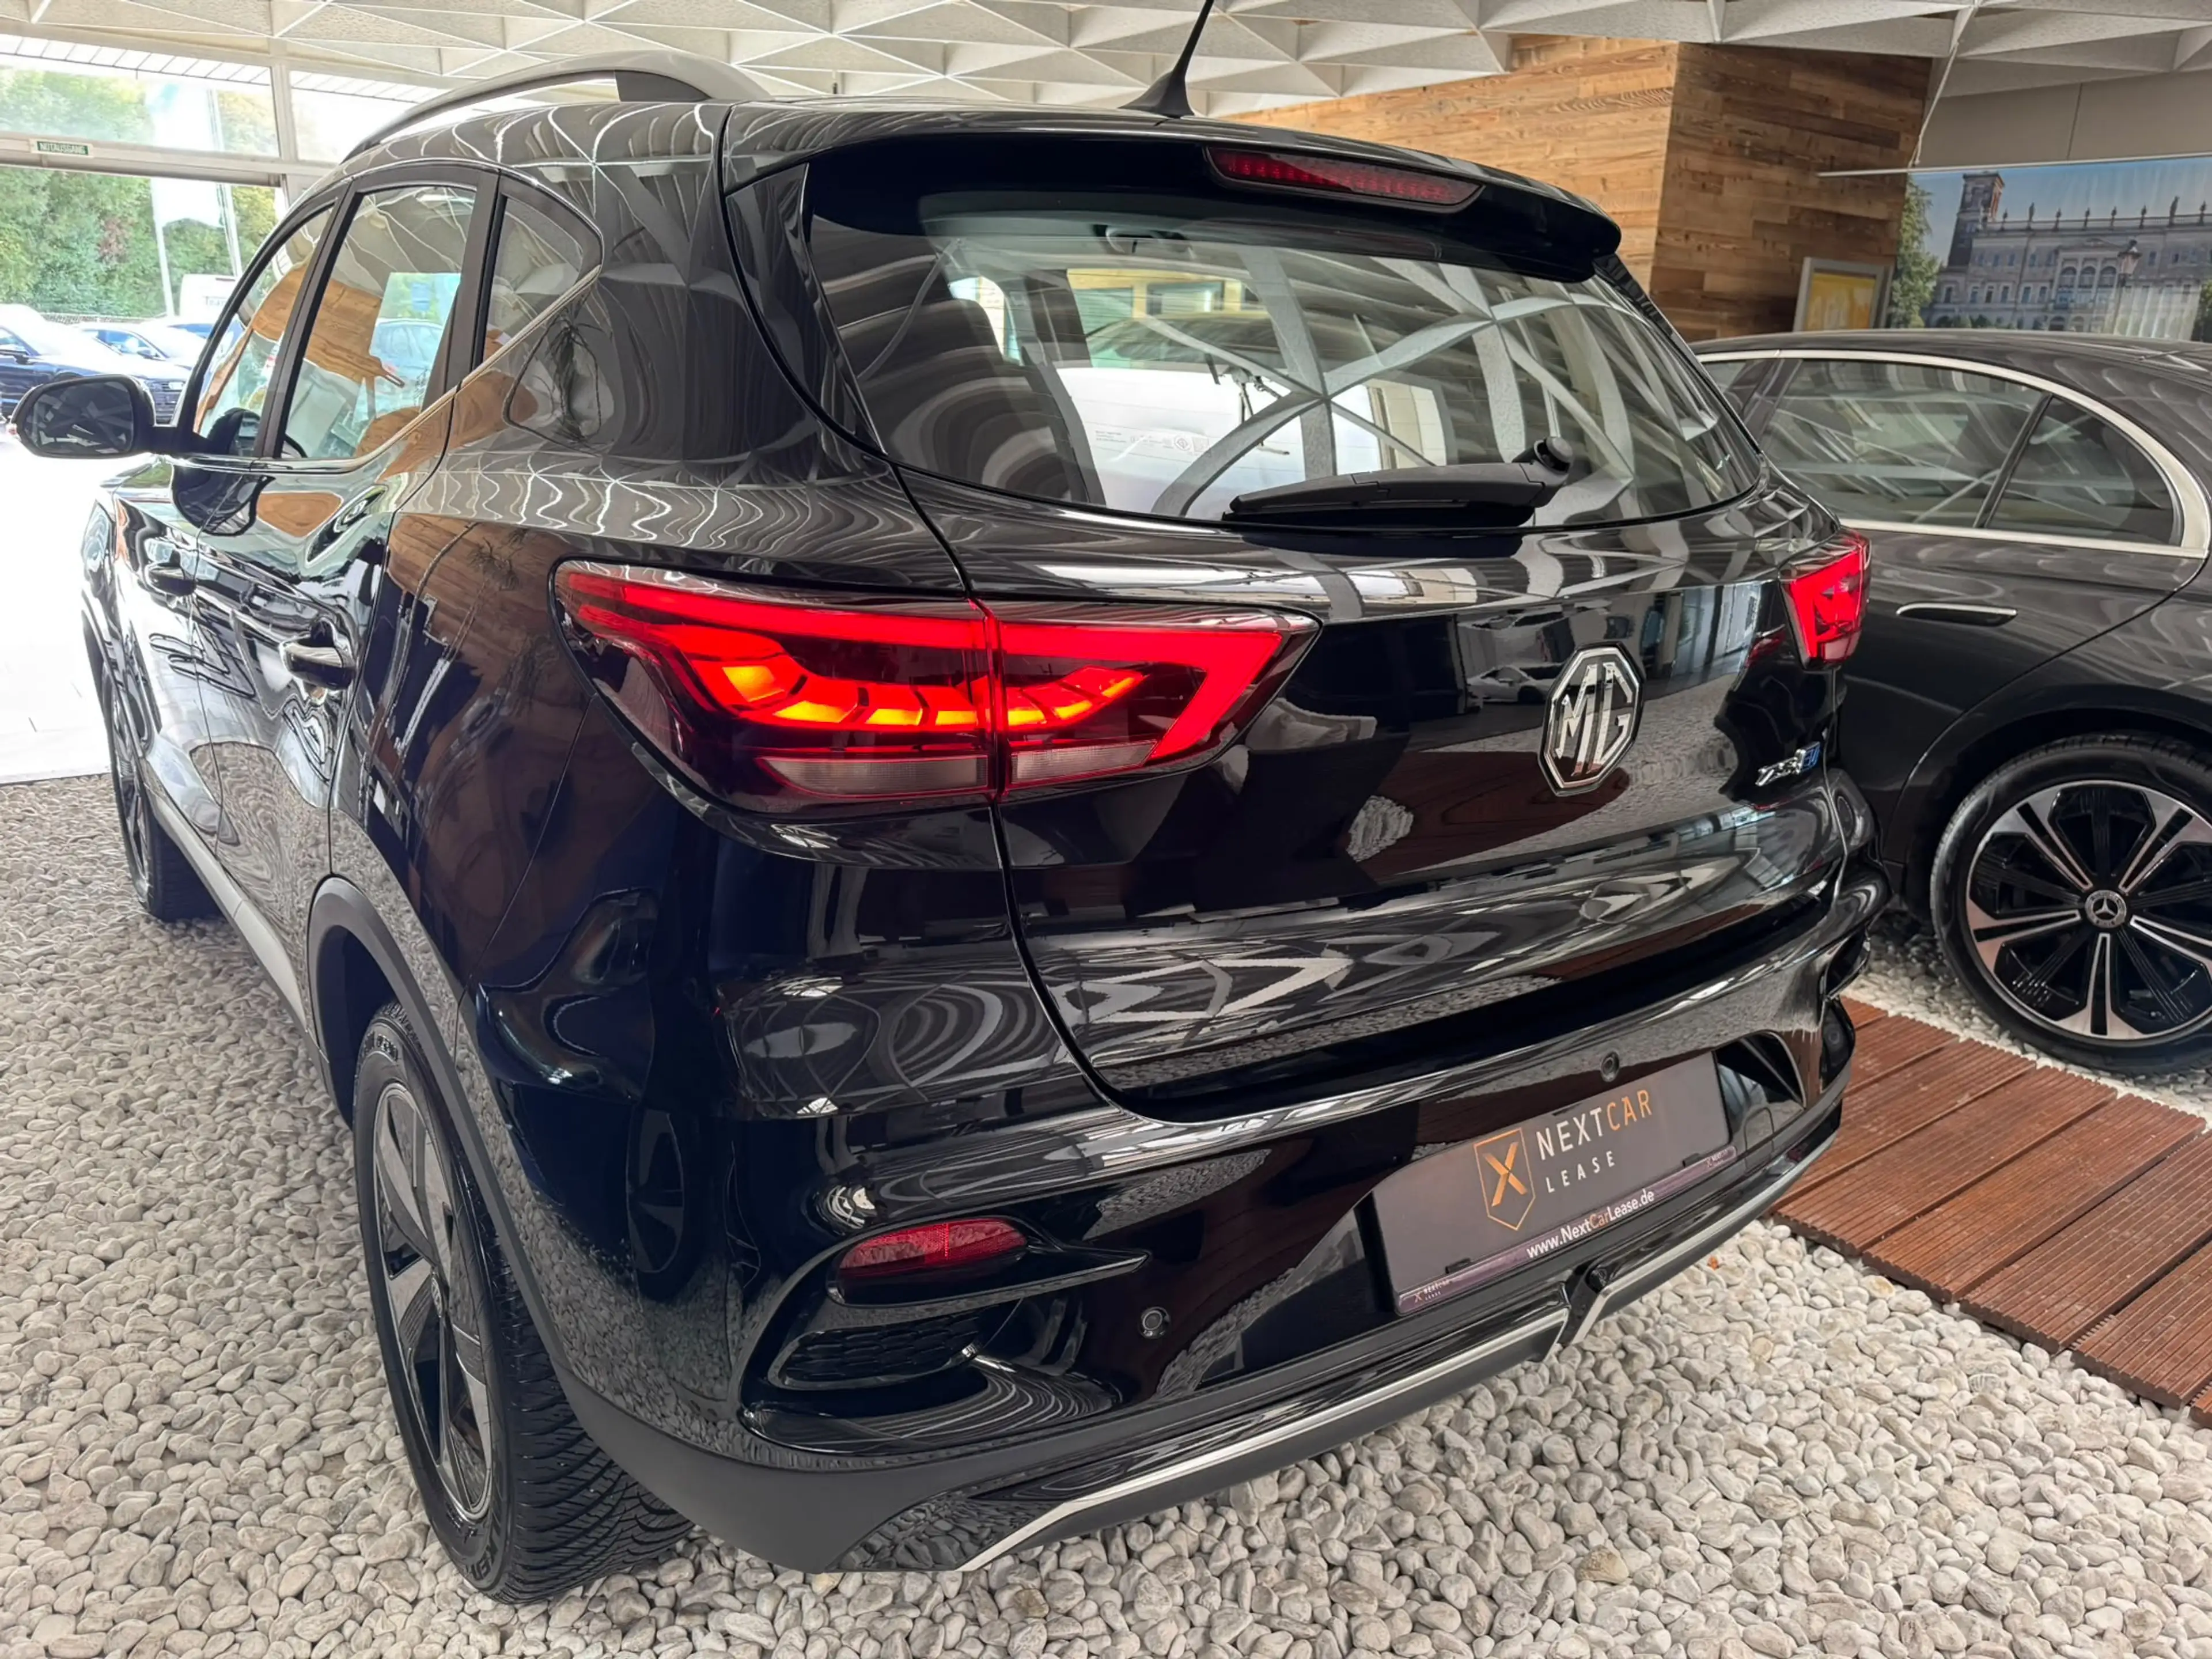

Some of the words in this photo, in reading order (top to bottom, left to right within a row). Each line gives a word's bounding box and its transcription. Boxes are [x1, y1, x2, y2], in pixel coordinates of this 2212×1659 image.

[1555, 662, 1634, 777] MG
[1536, 1089, 1653, 1161] NEXTCAR
[1546, 1150, 1616, 1193] LEASE
[1527, 1188, 1654, 1259] www.NextCarLease.de
